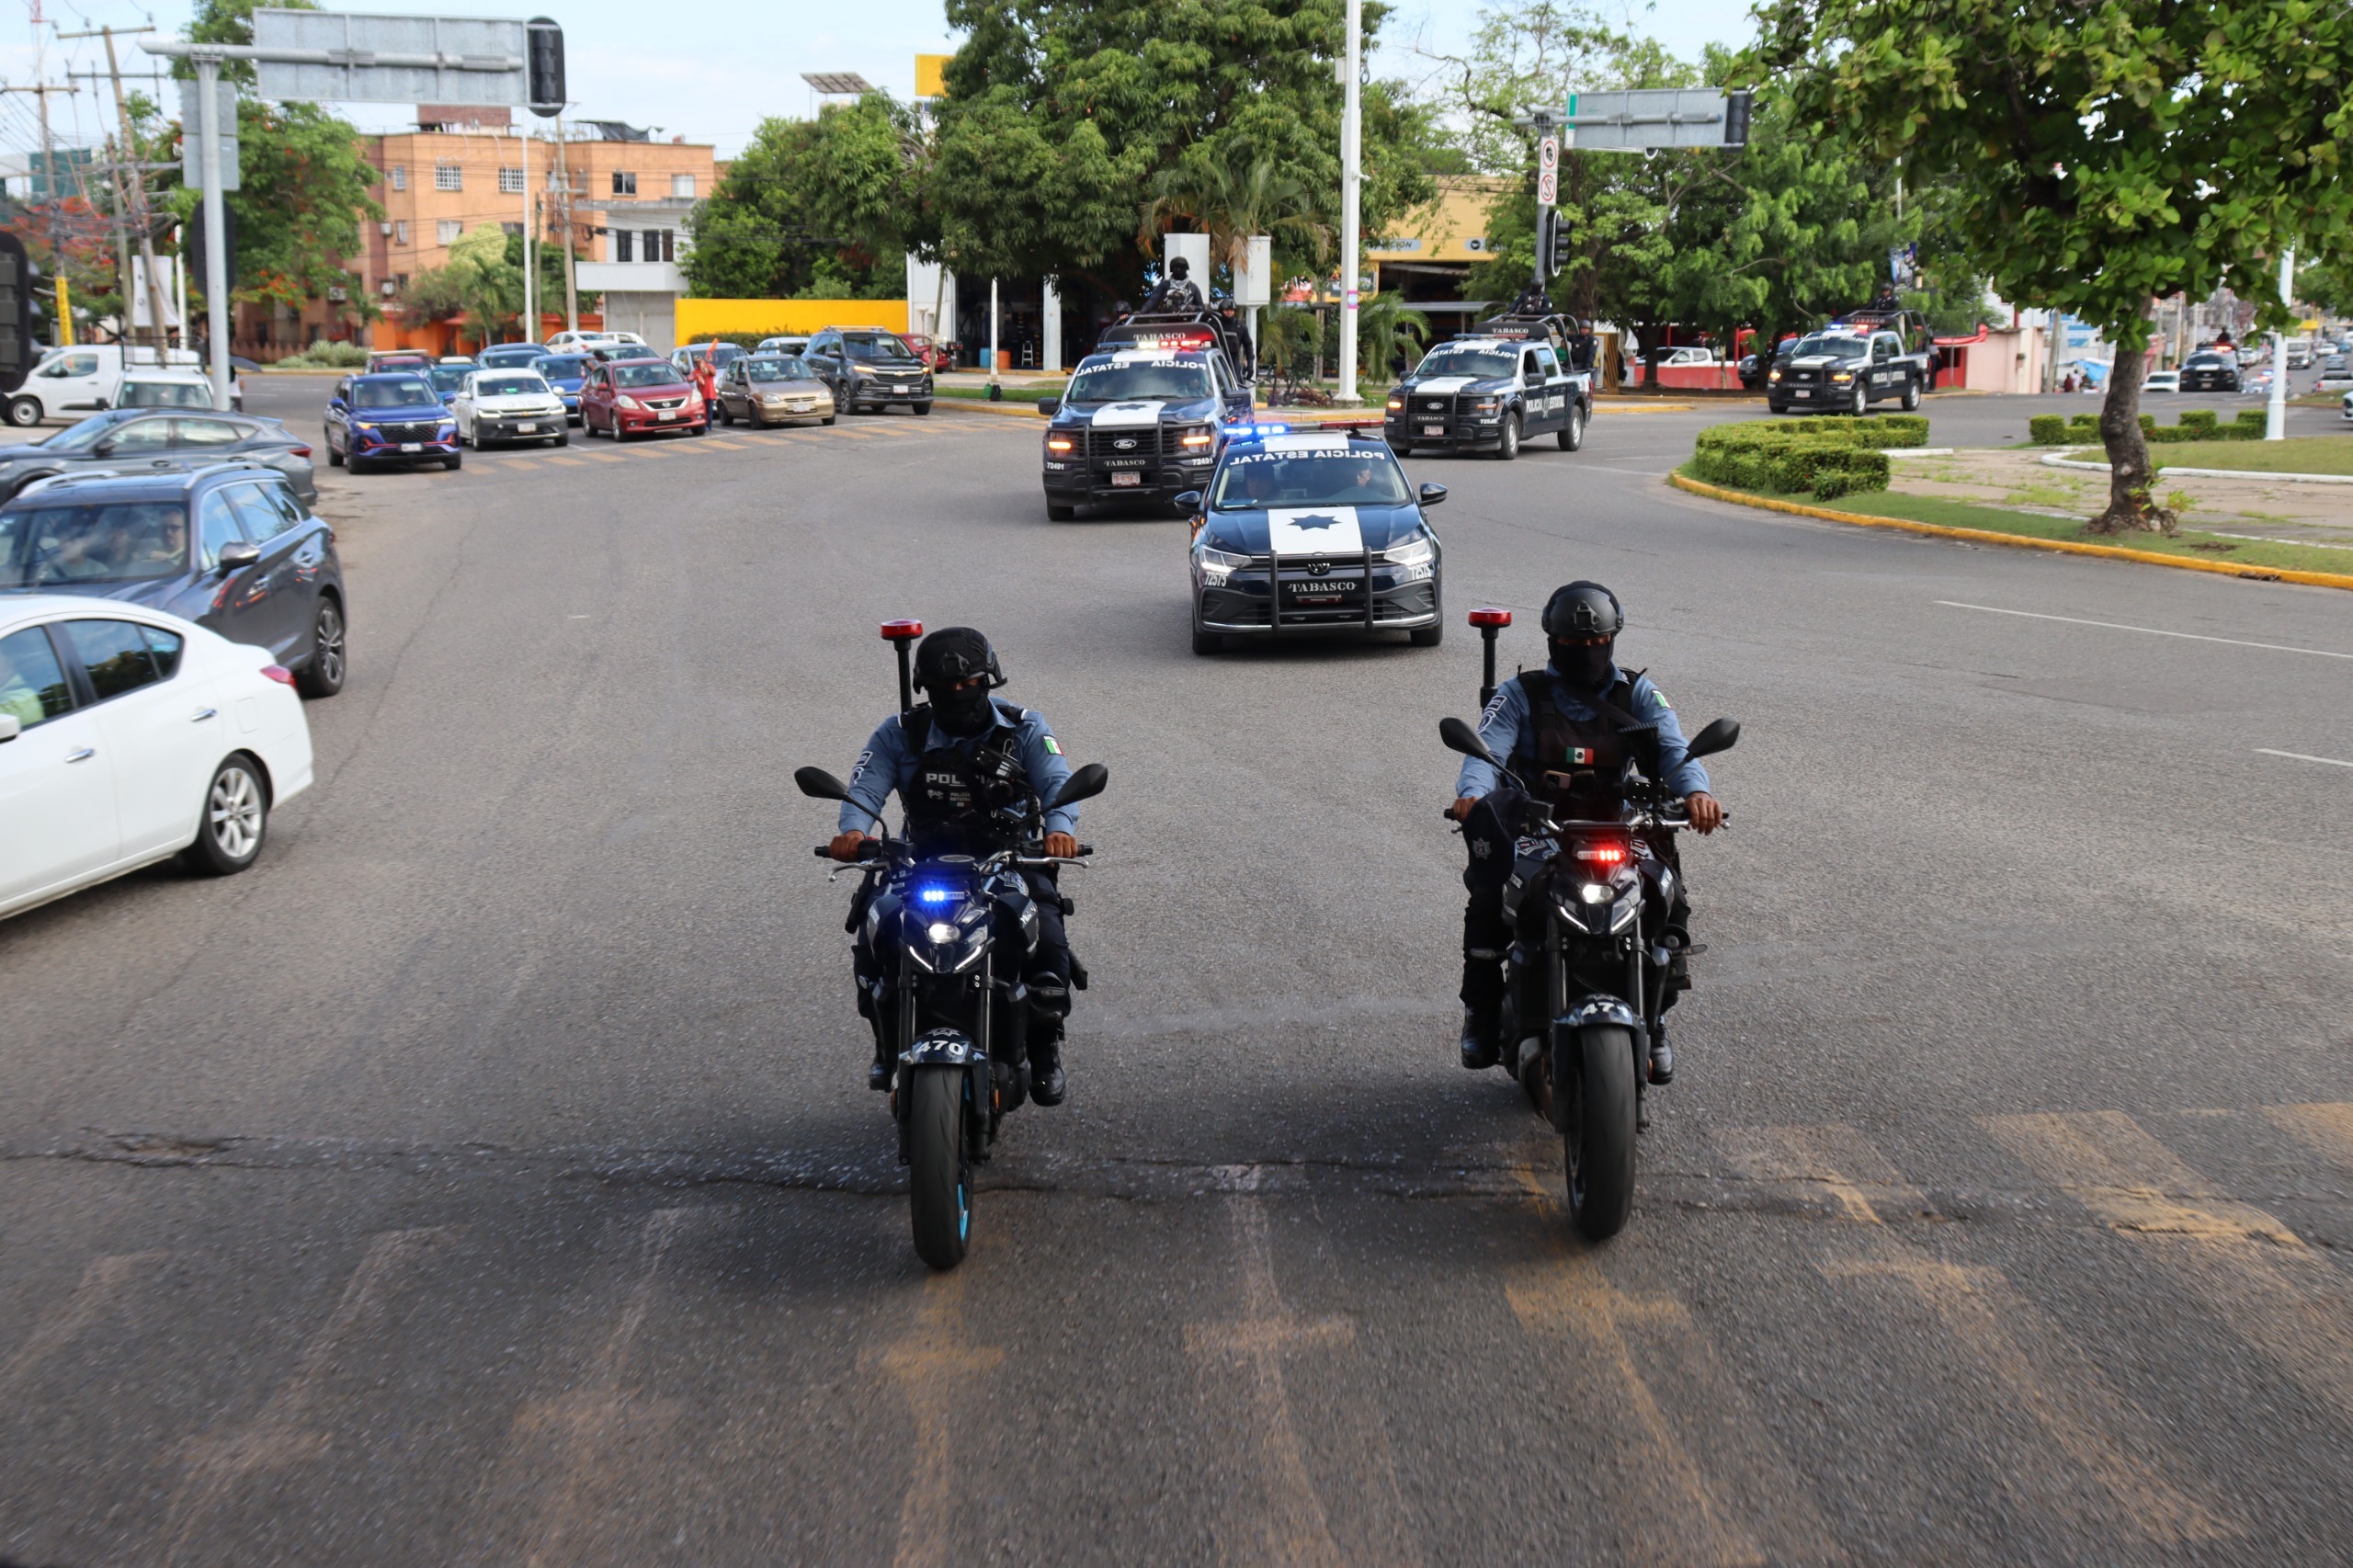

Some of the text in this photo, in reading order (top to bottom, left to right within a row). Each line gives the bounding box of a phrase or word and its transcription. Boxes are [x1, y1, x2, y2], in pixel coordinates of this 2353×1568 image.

[1133, 332, 1186, 342] TABASCO
[1527, 395, 1565, 413] POLICIA ESTATAL
[1046, 461, 1064, 471] 72491
[1192, 457, 1213, 466] 72491
[1204, 571, 1227, 587] 72575
[1410, 566, 1431, 581] 72575
[1289, 581, 1356, 593] TABASCO
[1581, 1001, 1629, 1018] 471
[915, 1040, 964, 1056] 470
